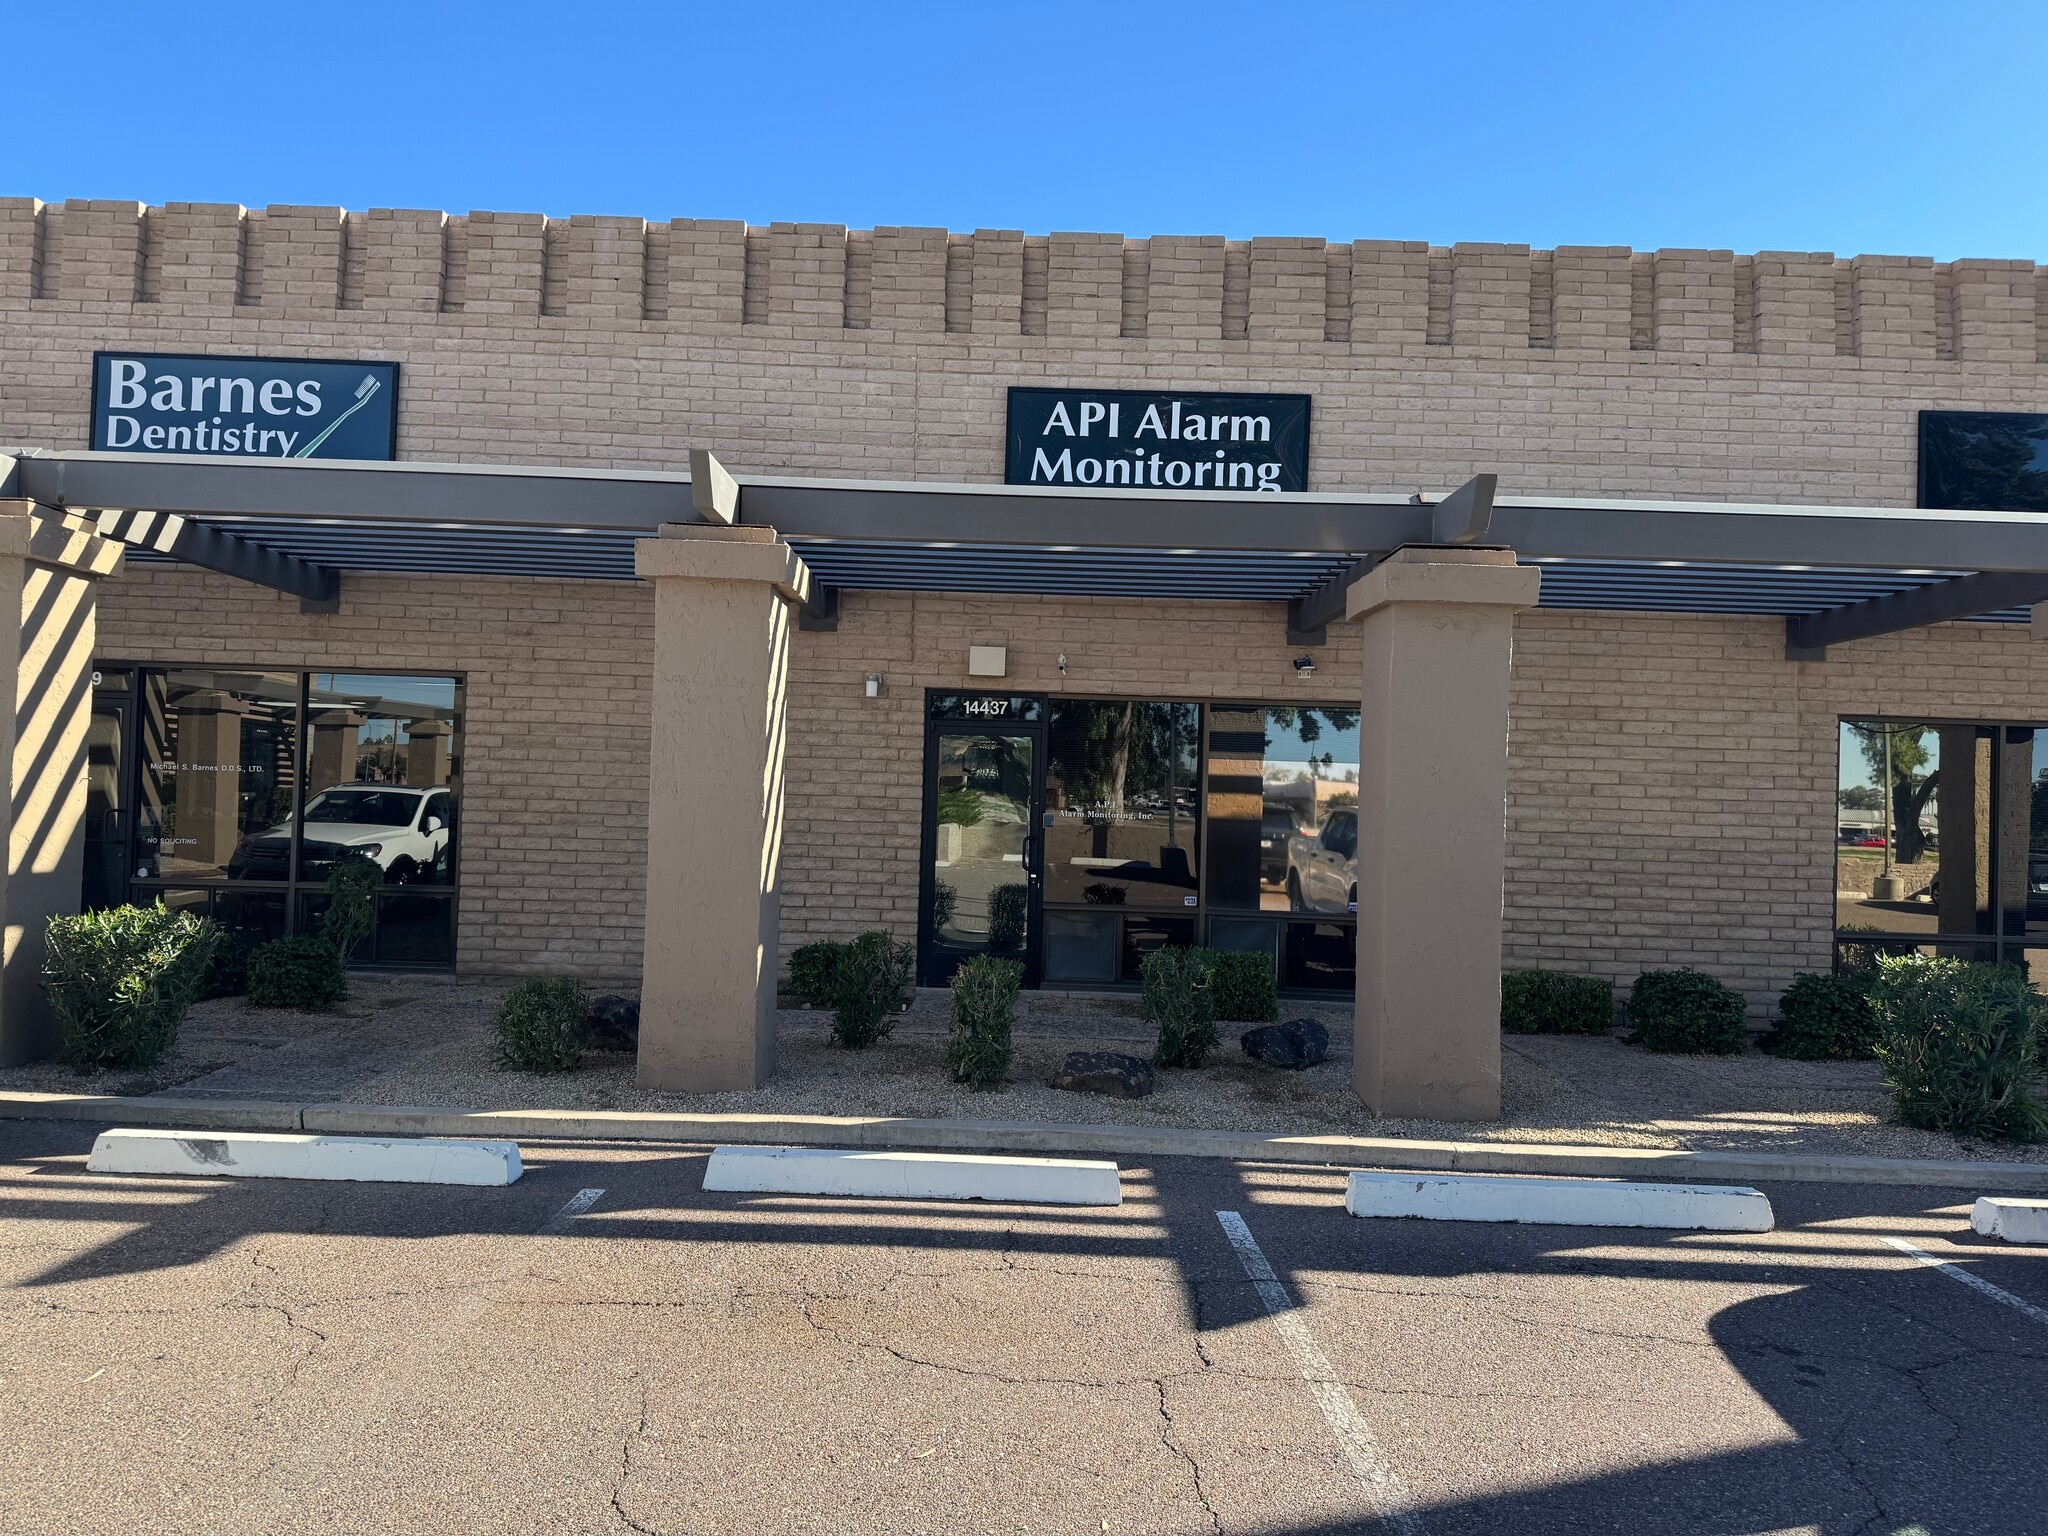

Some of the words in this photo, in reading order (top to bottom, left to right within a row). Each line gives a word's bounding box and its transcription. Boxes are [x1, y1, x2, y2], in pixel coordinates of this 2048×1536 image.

[109, 359, 322, 416] Barnes
[106, 415, 299, 457] Dentistry
[1042, 401, 1120, 438] API
[1134, 401, 1271, 442] Alarm
[1030, 447, 1282, 493] Monitoring
[963, 700, 1008, 715] 14437
[150, 763, 179, 771] Michael
[182, 763, 190, 771] S.
[248, 765, 264, 773] LTD.
[1059, 810, 1084, 818] Alarm
[1087, 810, 1136, 820] Monitoring,
[1138, 812, 1154, 820] Inc.
